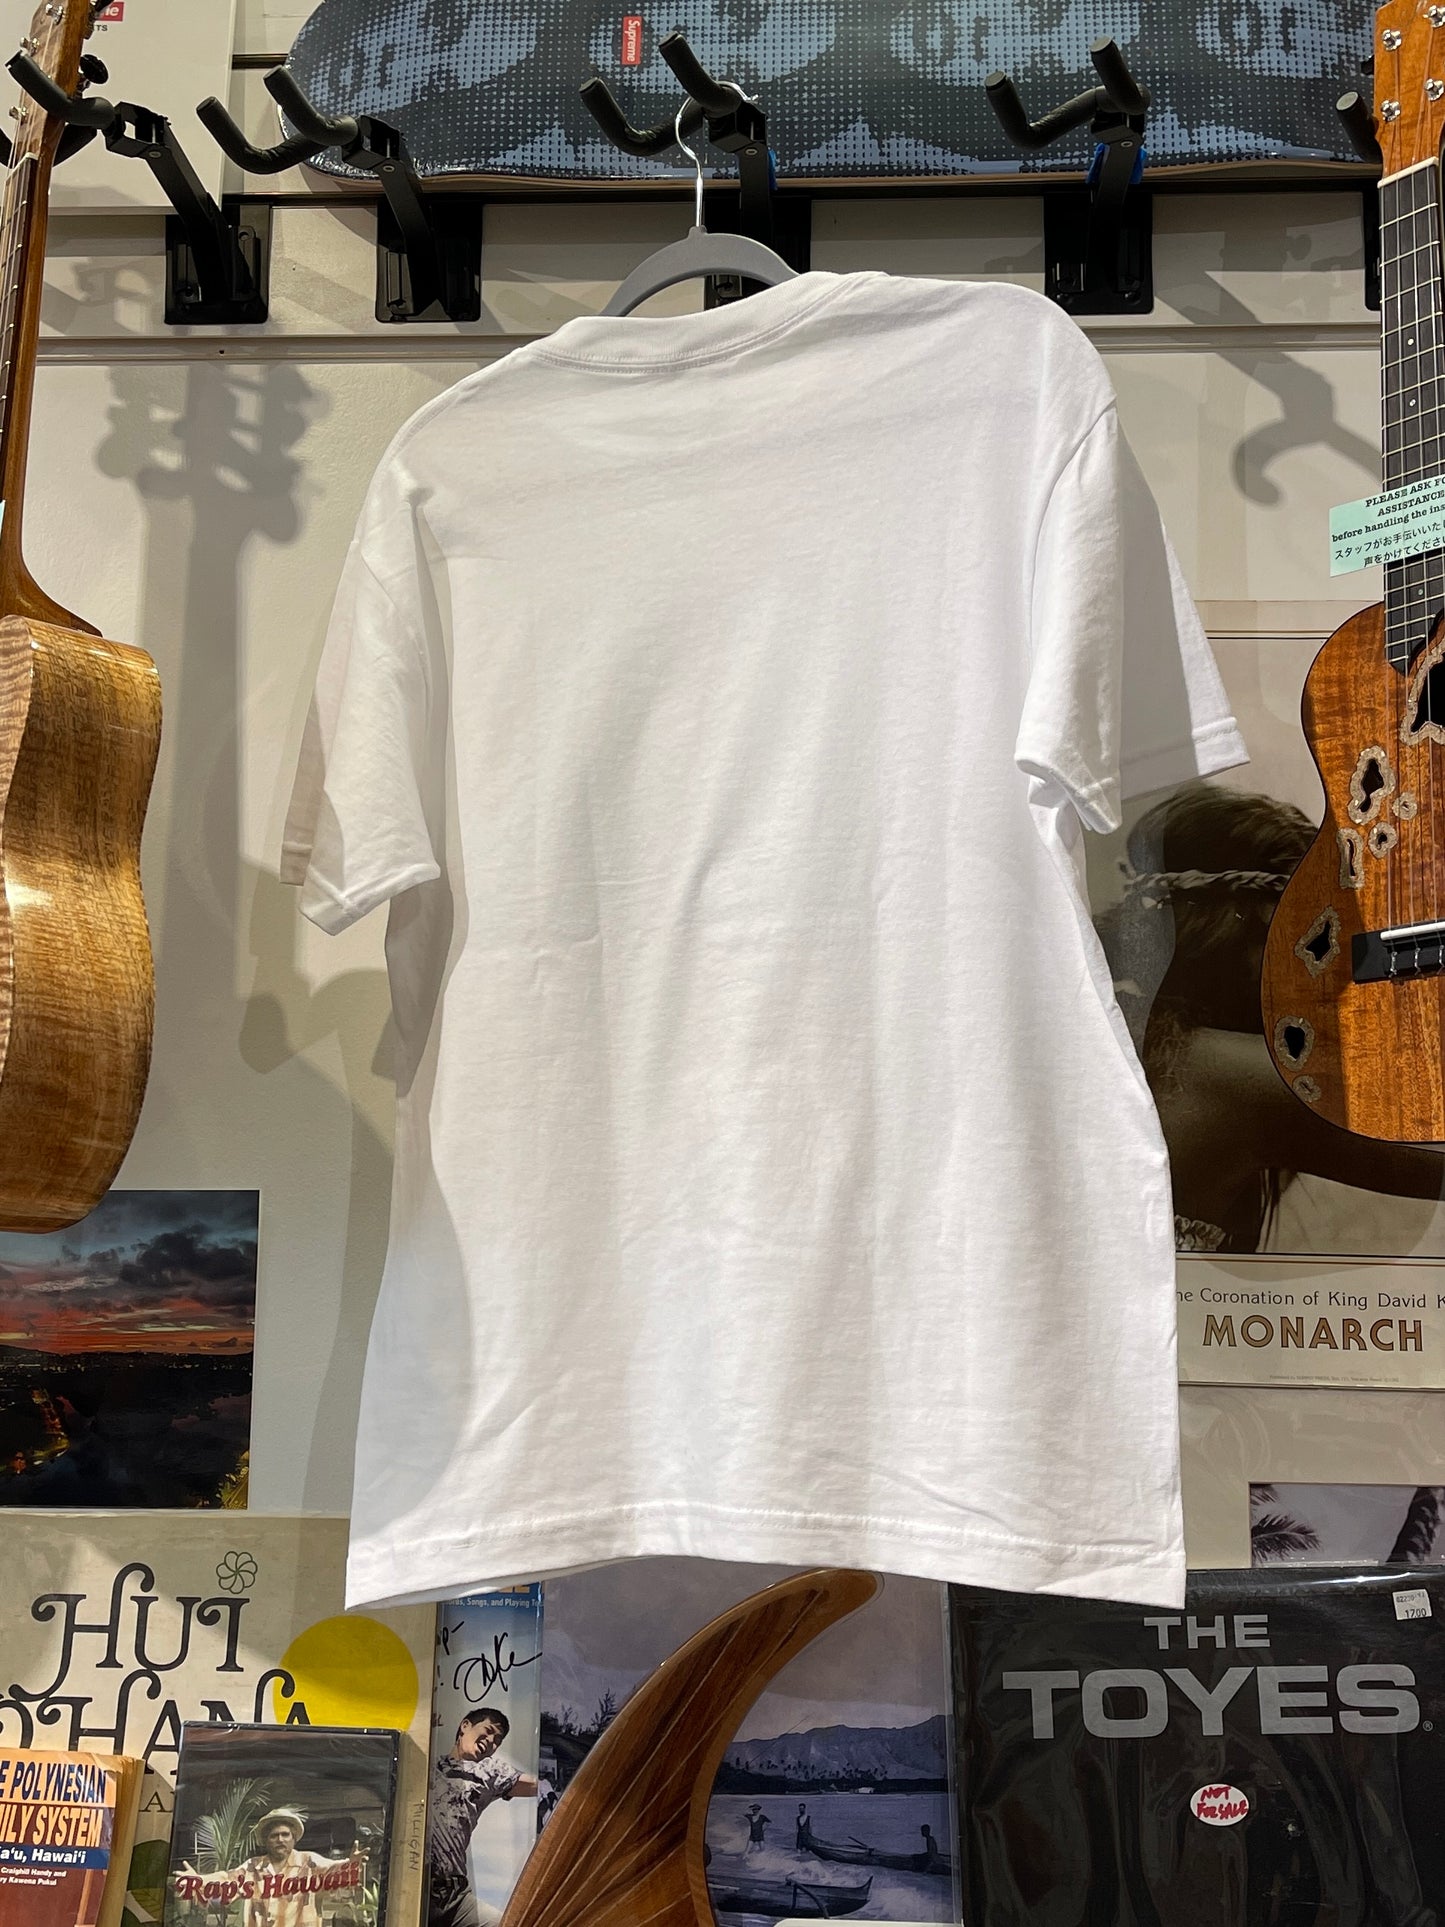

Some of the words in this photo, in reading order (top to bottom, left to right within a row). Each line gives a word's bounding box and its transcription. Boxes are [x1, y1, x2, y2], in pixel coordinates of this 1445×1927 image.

[626, 19, 641, 62] Supreme
[1365, 488, 1408, 507] PLEASE
[1409, 480, 1432, 495] ASK
[1377, 489, 1445, 517] ASSISTANCE
[1332, 528, 1363, 543] before
[1364, 513, 1410, 533] handling
[1411, 509, 1428, 519] the
[1199, 1287, 1295, 1306] Coronation
[1302, 1290, 1320, 1306] of
[1328, 1291, 1368, 1311] King
[1378, 1292, 1426, 1309] David
[1202, 1314, 1424, 1352] MONARCH
[504, 1598, 530, 1609] Playing
[9, 1562, 250, 1702] HUI
[1143, 1614, 1271, 1650] THE
[1002, 1664, 1421, 1740] TOYES
[9, 1761, 108, 1804] POLYNESIAN
[1200, 1786, 1232, 1802] NOT
[32, 1805, 104, 1848] SYSTEM
[408, 1803, 425, 1871] MILLIGAN
[31, 1848, 87, 1864] Hawai'i
[31, 1868, 53, 1878] Handy
[8, 1876, 37, 1885] Kawena
[174, 1872, 255, 1908] Rap's
[261, 1861, 361, 1900] Hawaii
